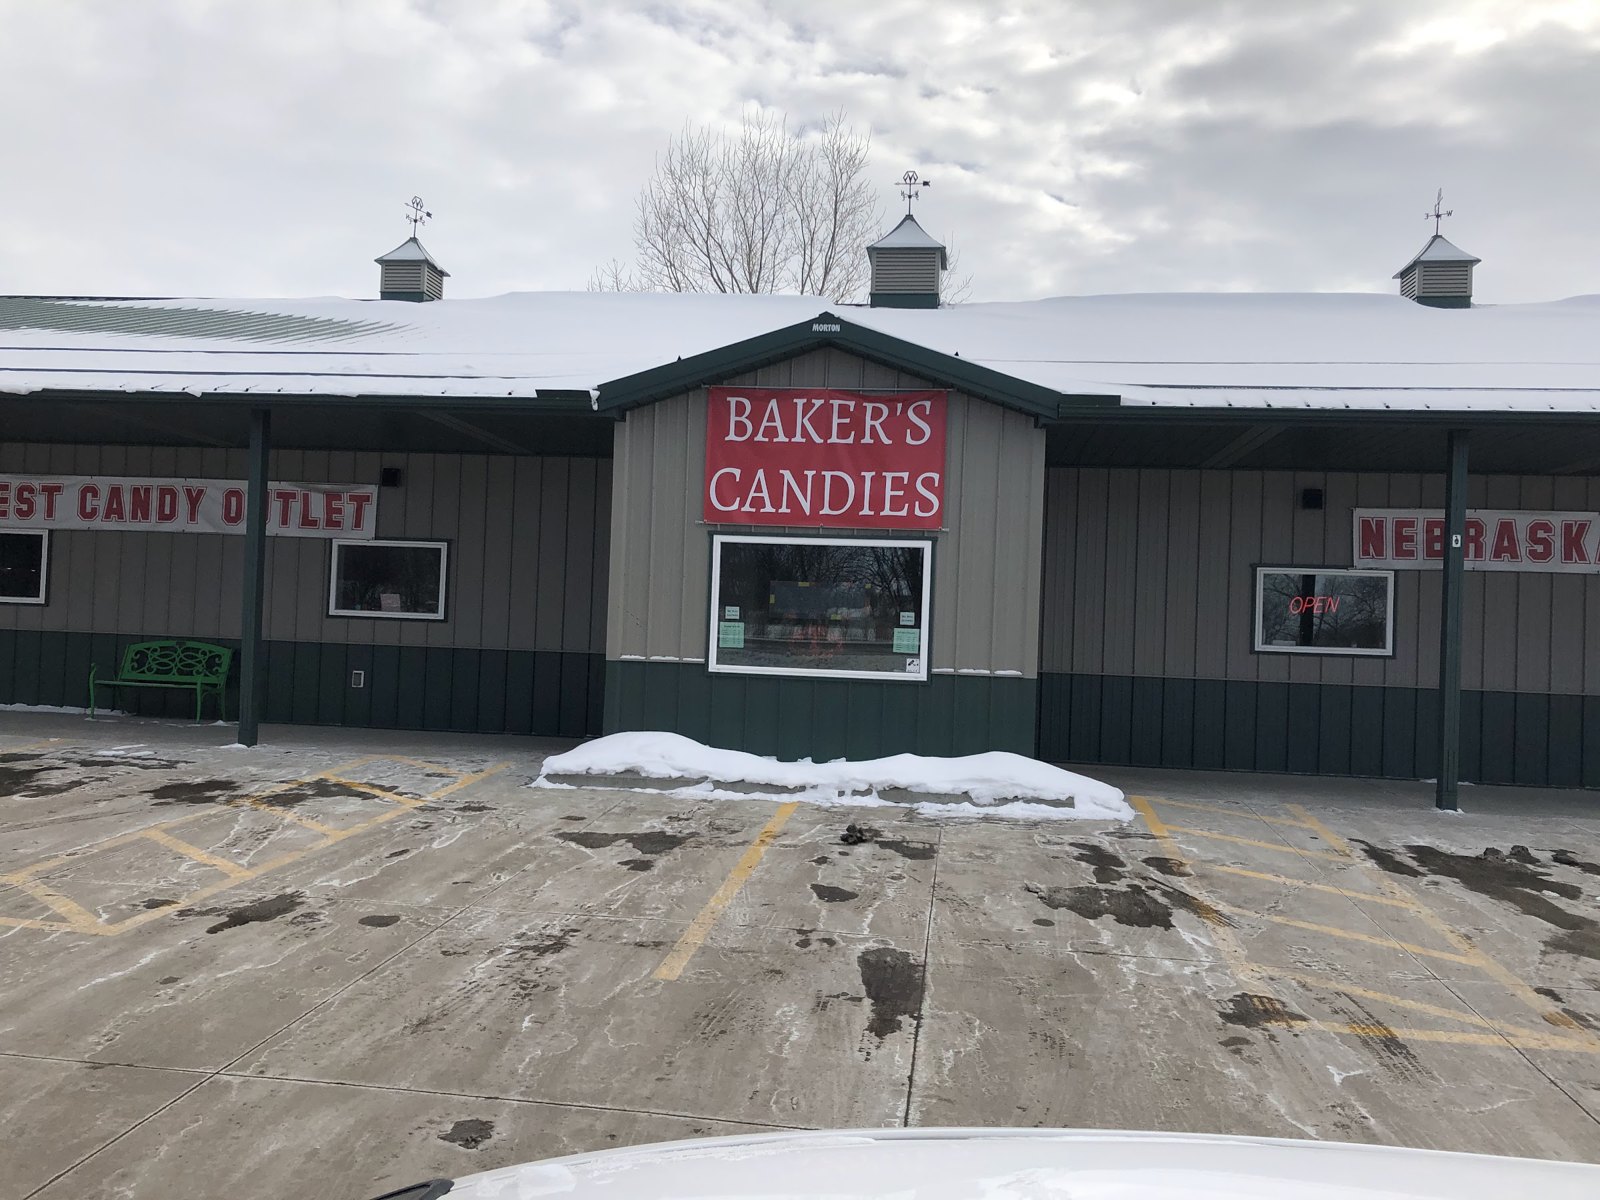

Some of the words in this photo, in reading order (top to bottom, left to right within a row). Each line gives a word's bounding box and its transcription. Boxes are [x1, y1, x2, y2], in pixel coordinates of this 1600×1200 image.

[812, 323, 840, 332] MORTON
[724, 396, 932, 446] BAKER'S
[77, 483, 207, 524] CANDY
[221, 487, 373, 530] OTLET
[709, 467, 940, 517] CANDIES
[1359, 516, 1600, 564] NEBRASK
[1289, 596, 1340, 614] OPEN
